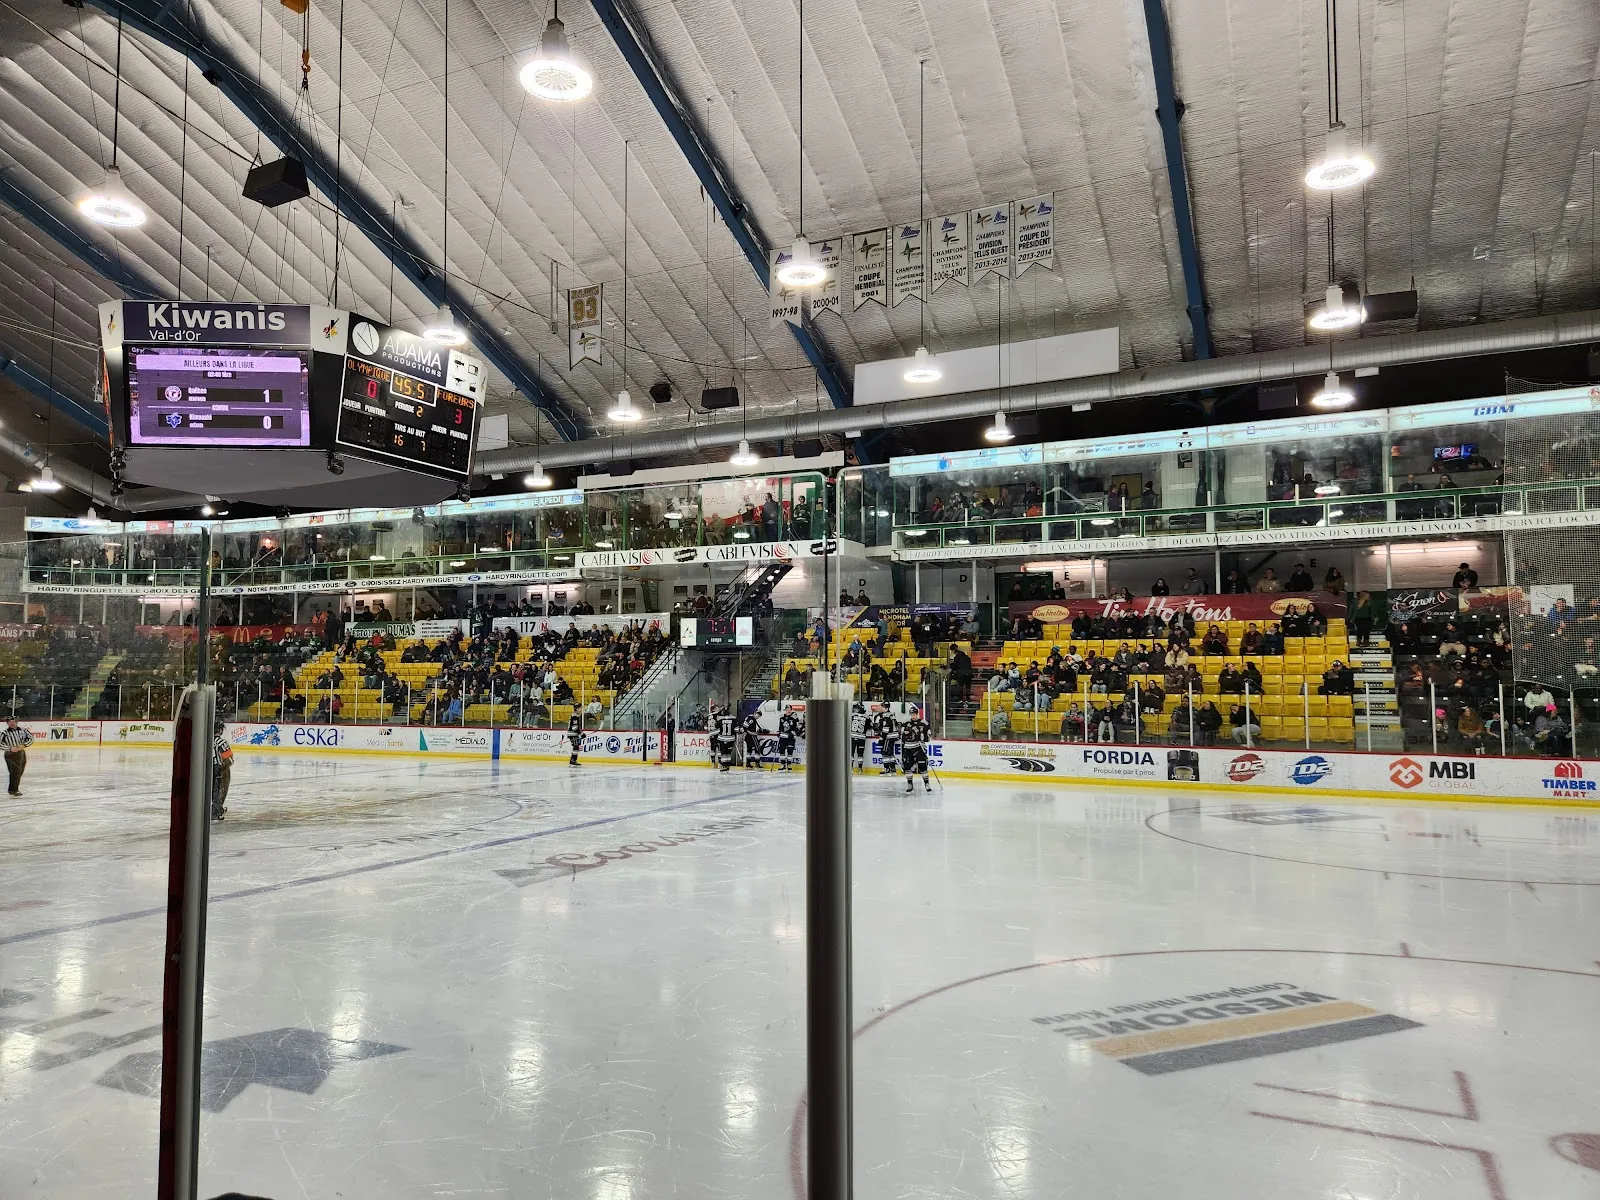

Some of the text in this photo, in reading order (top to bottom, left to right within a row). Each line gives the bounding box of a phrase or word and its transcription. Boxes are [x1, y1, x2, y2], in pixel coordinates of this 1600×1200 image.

[1019, 221, 1050, 233] CHAMPIONS
[975, 229, 1005, 241] CHAMPIONS
[1019, 230, 1050, 243] COUPE DU
[978, 239, 1003, 250] DIVISION
[932, 246, 968, 258] CHAMPIONS
[973, 246, 1009, 259] TELUS OUEST
[1018, 249, 1052, 262] 2013-2014
[936, 254, 963, 264] DIVISION
[974, 256, 1008, 270] 2013-2014
[854, 261, 885, 272] FINALISTE
[858, 272, 881, 282] COUPE
[861, 290, 879, 298] 2001
[812, 296, 839, 309] 2000-01
[148, 303, 286, 331] Kiwanis
[772, 306, 798, 318] 1997-98
[149, 329, 202, 341] Val-d'Or
[383, 335, 442, 371] ADAMA
[382, 351, 442, 378] PRODUCTIONS
[367, 380, 378, 399] 0
[263, 389, 271, 403] 1
[437, 388, 475, 409] FOREURS
[416, 405, 424, 418] 2
[454, 409, 463, 425] 3
[263, 415, 272, 430] 0
[393, 434, 404, 447] 16
[420, 440, 426, 452] 7
[1505, 516, 1556, 528] SERVICE
[1256, 530, 1326, 542] INNOVATIONS
[1352, 524, 1418, 536] VÉHICULES
[1420, 521, 1473, 533] LINCOLN
[1051, 542, 1092, 551] EXCLUSIF
[1109, 538, 1145, 548] RÉGION
[1309, 558, 1317, 568] E
[485, 571, 568, 581] HARDYRINGUETTE.com
[959, 574, 968, 584] D
[361, 579, 401, 587] CHOISISSEZ
[859, 578, 867, 588] D
[878, 607, 910, 615] MICROTEL
[387, 623, 416, 637] DUMAS
[519, 621, 536, 633] 117
[722, 724, 732, 736] 11
[294, 727, 338, 746] eska
[583, 743, 603, 753] Line
[1083, 750, 1155, 766] FORDIA
[1429, 761, 1476, 780] MBI
[1428, 780, 1476, 789] GLOBAL
[1541, 778, 1597, 791] TIMBER
[1552, 790, 1587, 798] MART
[1052, 989, 1341, 1042] WESDOME
